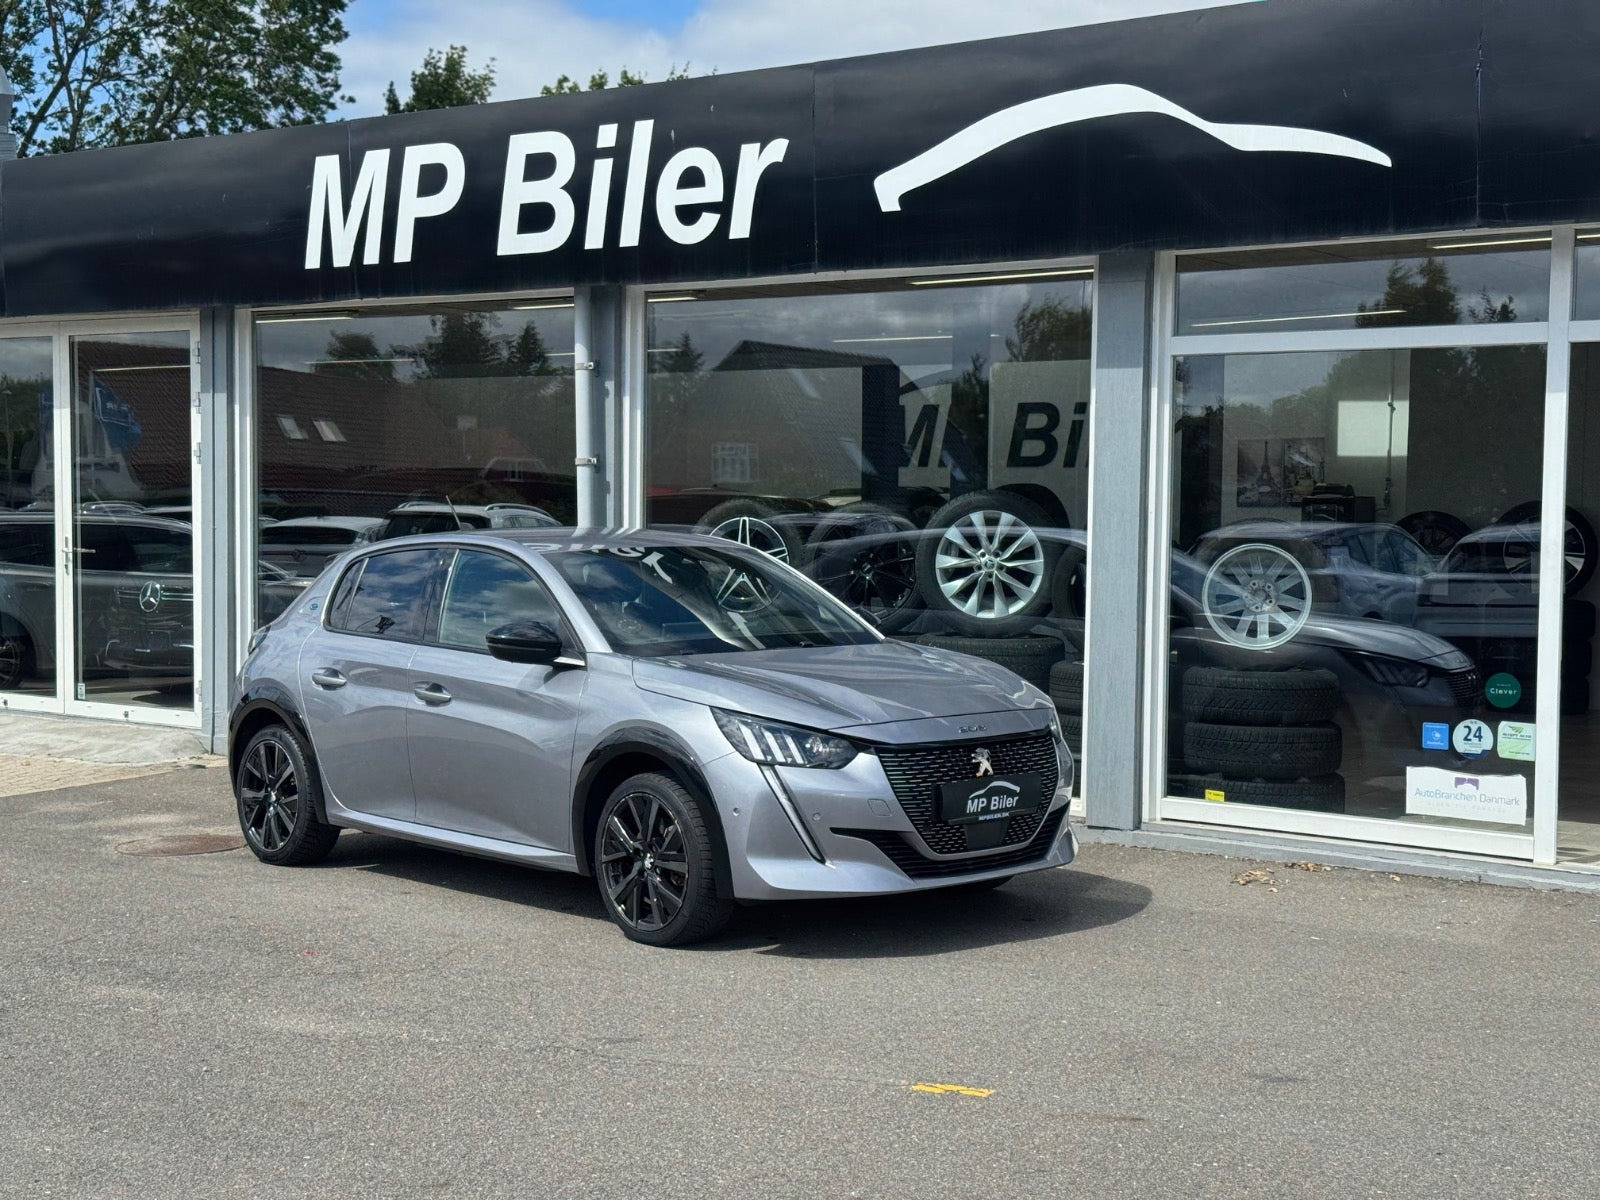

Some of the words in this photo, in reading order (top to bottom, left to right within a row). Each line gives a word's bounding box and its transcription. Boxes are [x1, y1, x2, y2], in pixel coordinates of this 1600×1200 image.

[304, 142, 466, 270] MP
[498, 119, 790, 256] Biler
[1006, 402, 1089, 468] Bi
[1490, 687, 1517, 696] Clever
[1463, 725, 1484, 742] 24
[966, 798, 987, 813] MP
[990, 795, 1019, 810] Biler
[1414, 787, 1477, 802] AutoBranchen
[1479, 793, 1521, 806] Danmark
